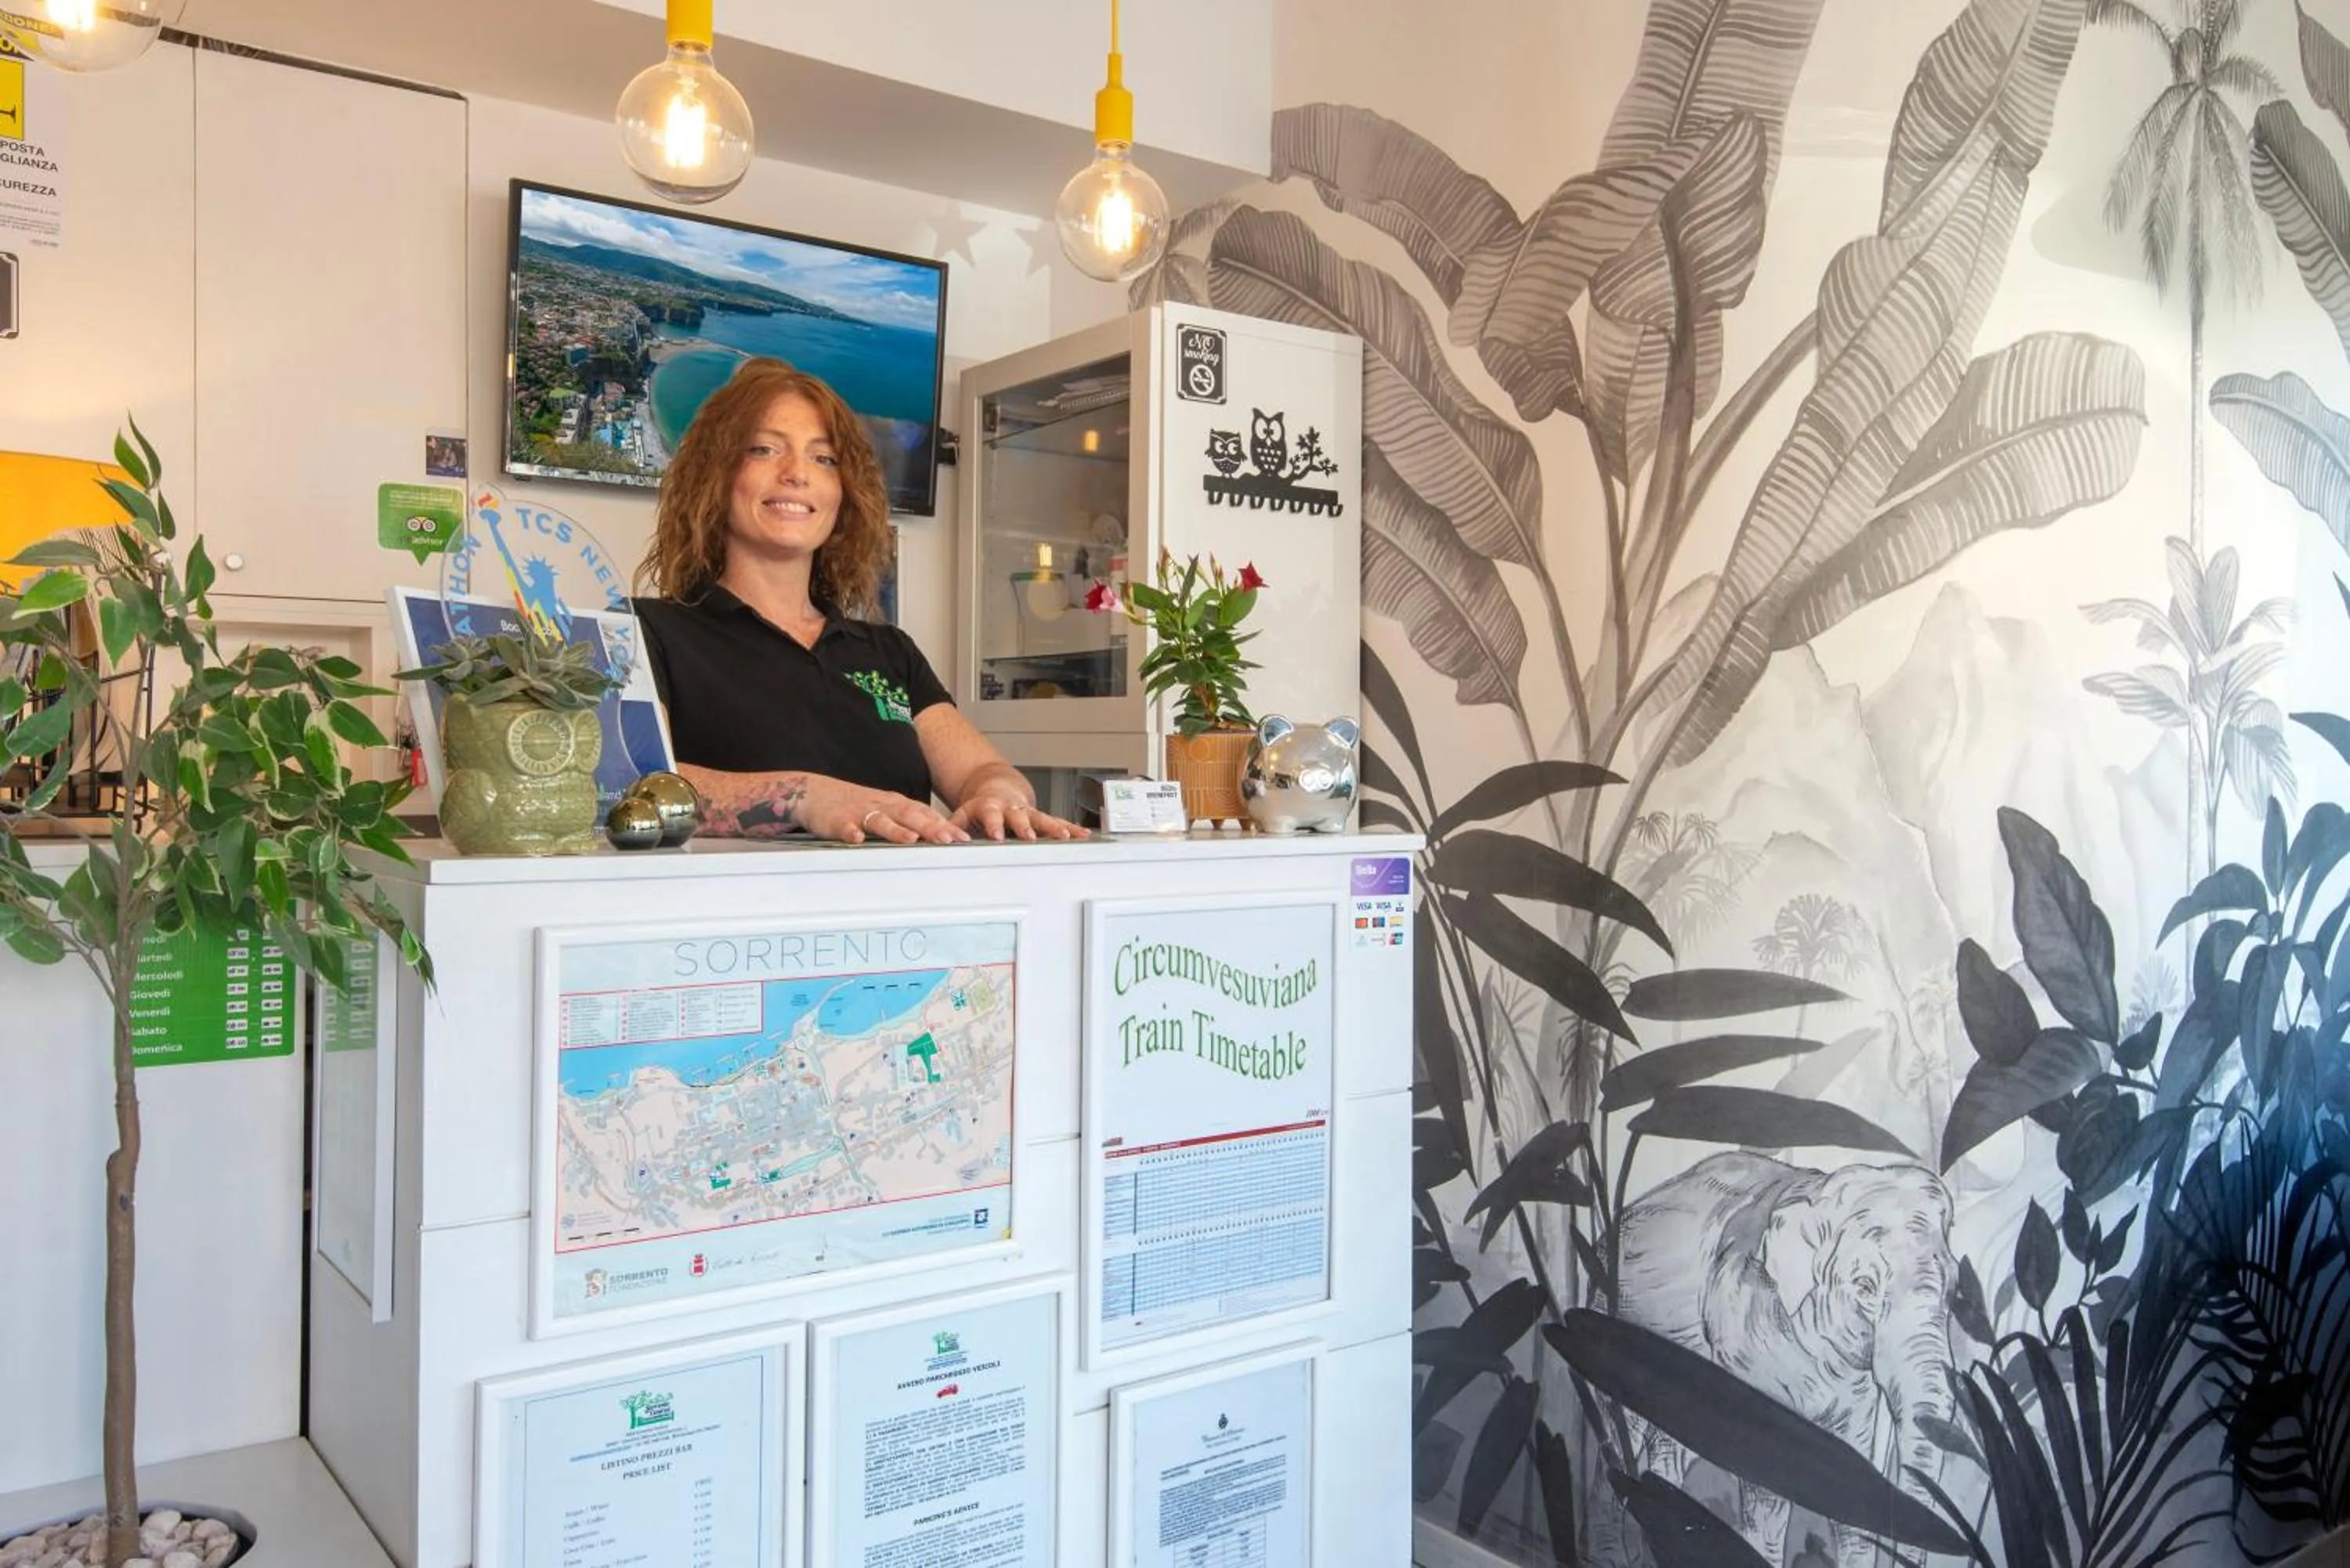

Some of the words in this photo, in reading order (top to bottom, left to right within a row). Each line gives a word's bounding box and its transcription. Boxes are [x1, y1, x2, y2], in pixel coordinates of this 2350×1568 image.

[0, 153, 59, 172] GLIANZA
[0, 179, 57, 197] UREZZA
[515, 508, 573, 544] TCS
[449, 533, 482, 637] ATHON
[580, 545, 626, 609] NEW
[605, 627, 631, 683] YOR
[674, 929, 927, 977] SORRENTO
[1115, 935, 1317, 1009] Circumvesuviana
[1119, 1003, 1184, 1067] Train
[1192, 1010, 1307, 1080] Timetable
[610, 1267, 668, 1284] SORRENTO
[601, 1456, 639, 1471] LISTINO
[641, 1448, 673, 1461] PREZZI
[623, 1469, 649, 1479] PRICE
[652, 1463, 671, 1473] LIST
